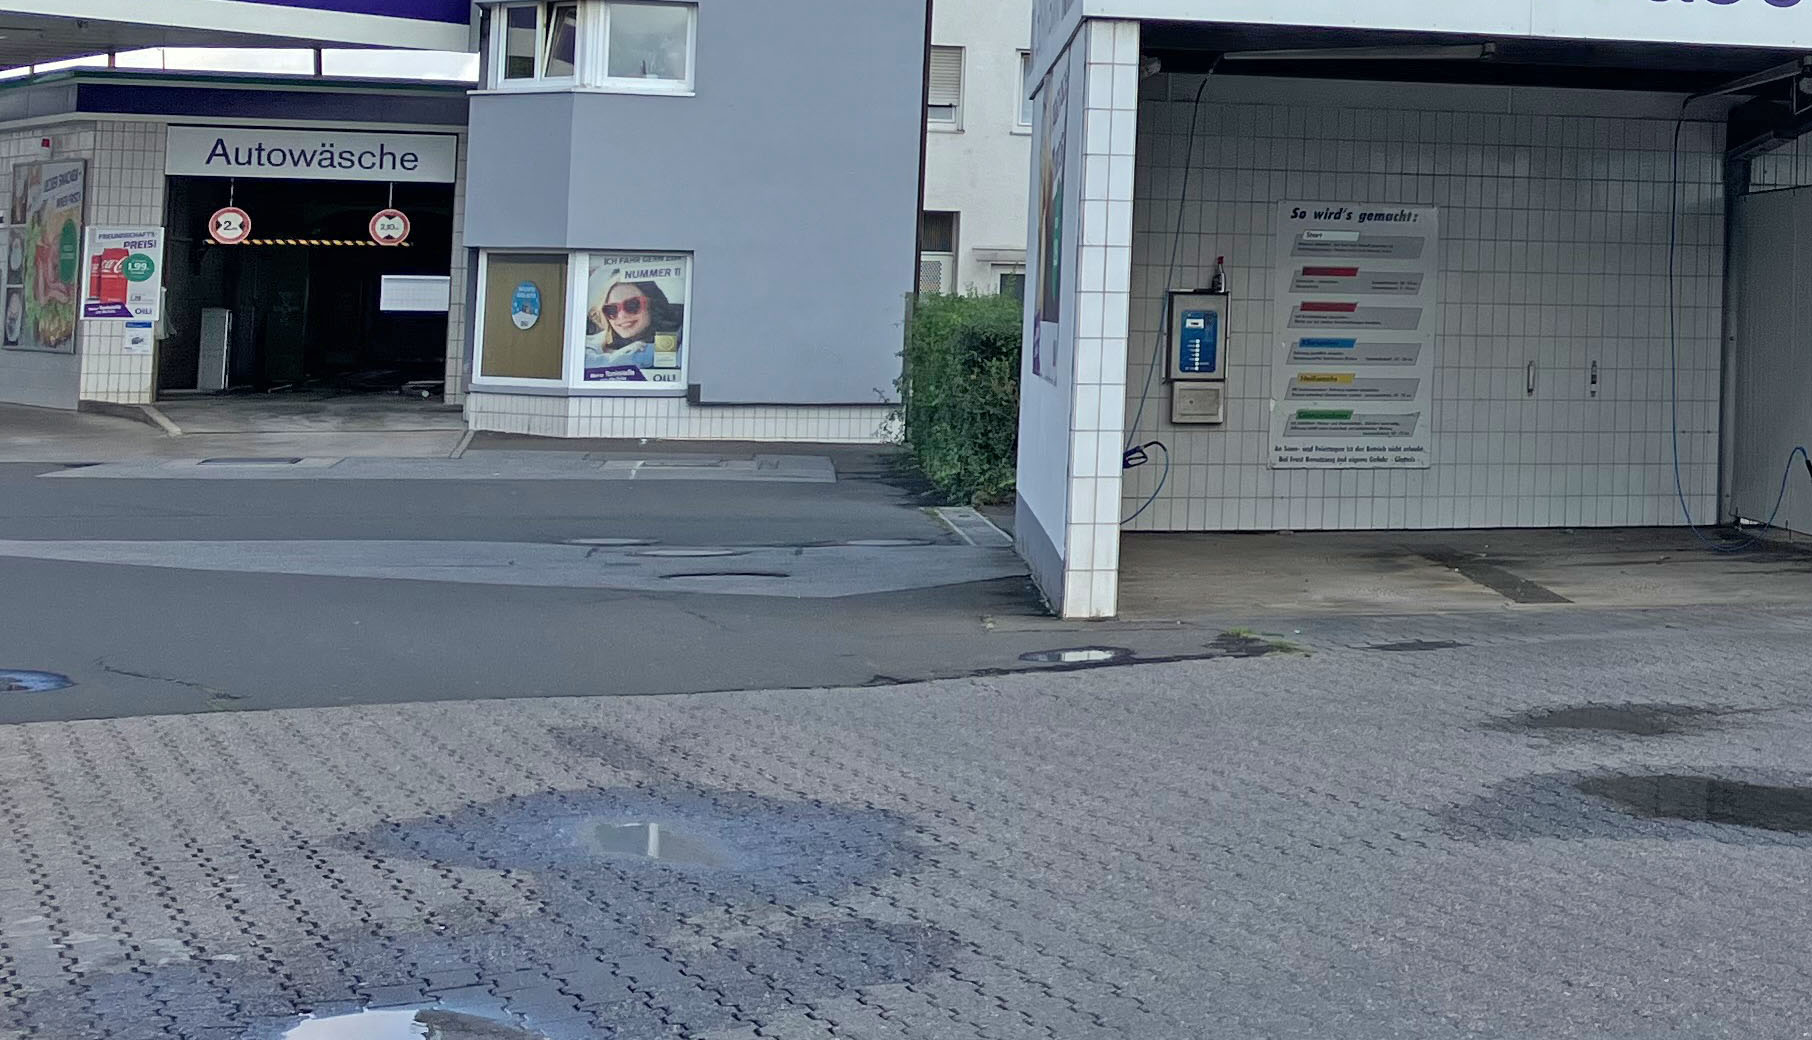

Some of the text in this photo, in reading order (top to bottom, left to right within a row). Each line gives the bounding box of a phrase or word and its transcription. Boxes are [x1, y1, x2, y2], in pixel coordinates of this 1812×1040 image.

[205, 138, 419, 171] Autowäsche
[1291, 207, 1418, 223] So wird's gemacht:
[625, 269, 671, 279] NUMMER
